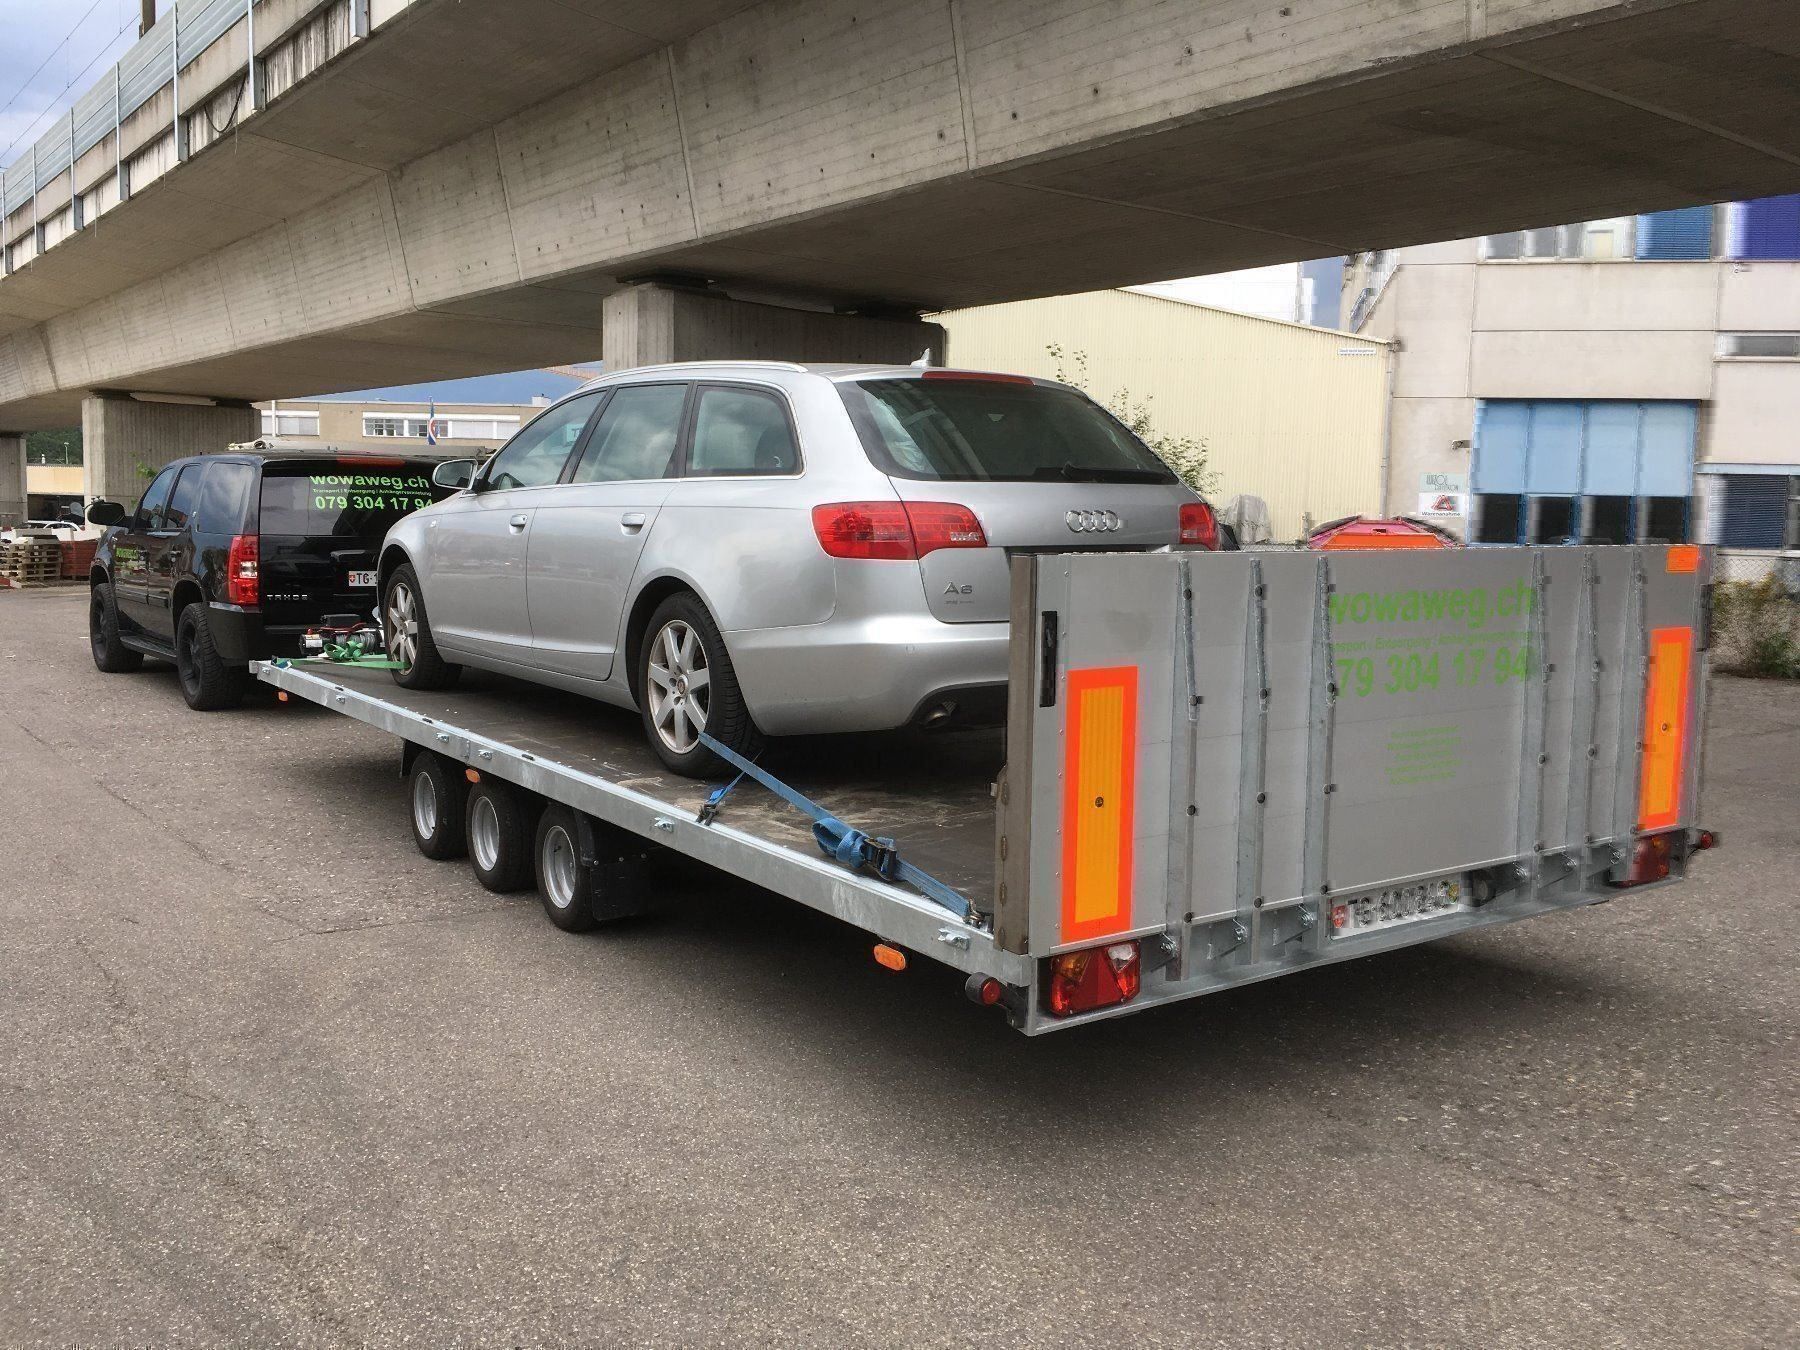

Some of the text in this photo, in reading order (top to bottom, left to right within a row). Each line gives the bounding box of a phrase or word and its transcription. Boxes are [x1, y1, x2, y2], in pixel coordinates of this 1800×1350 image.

[310, 475, 430, 490] wowaweg.ch
[315, 495, 348, 510] 079
[352, 495, 385, 510] 304
[390, 496, 409, 511] 17
[1334, 645, 1533, 698] 79 304 17 94
